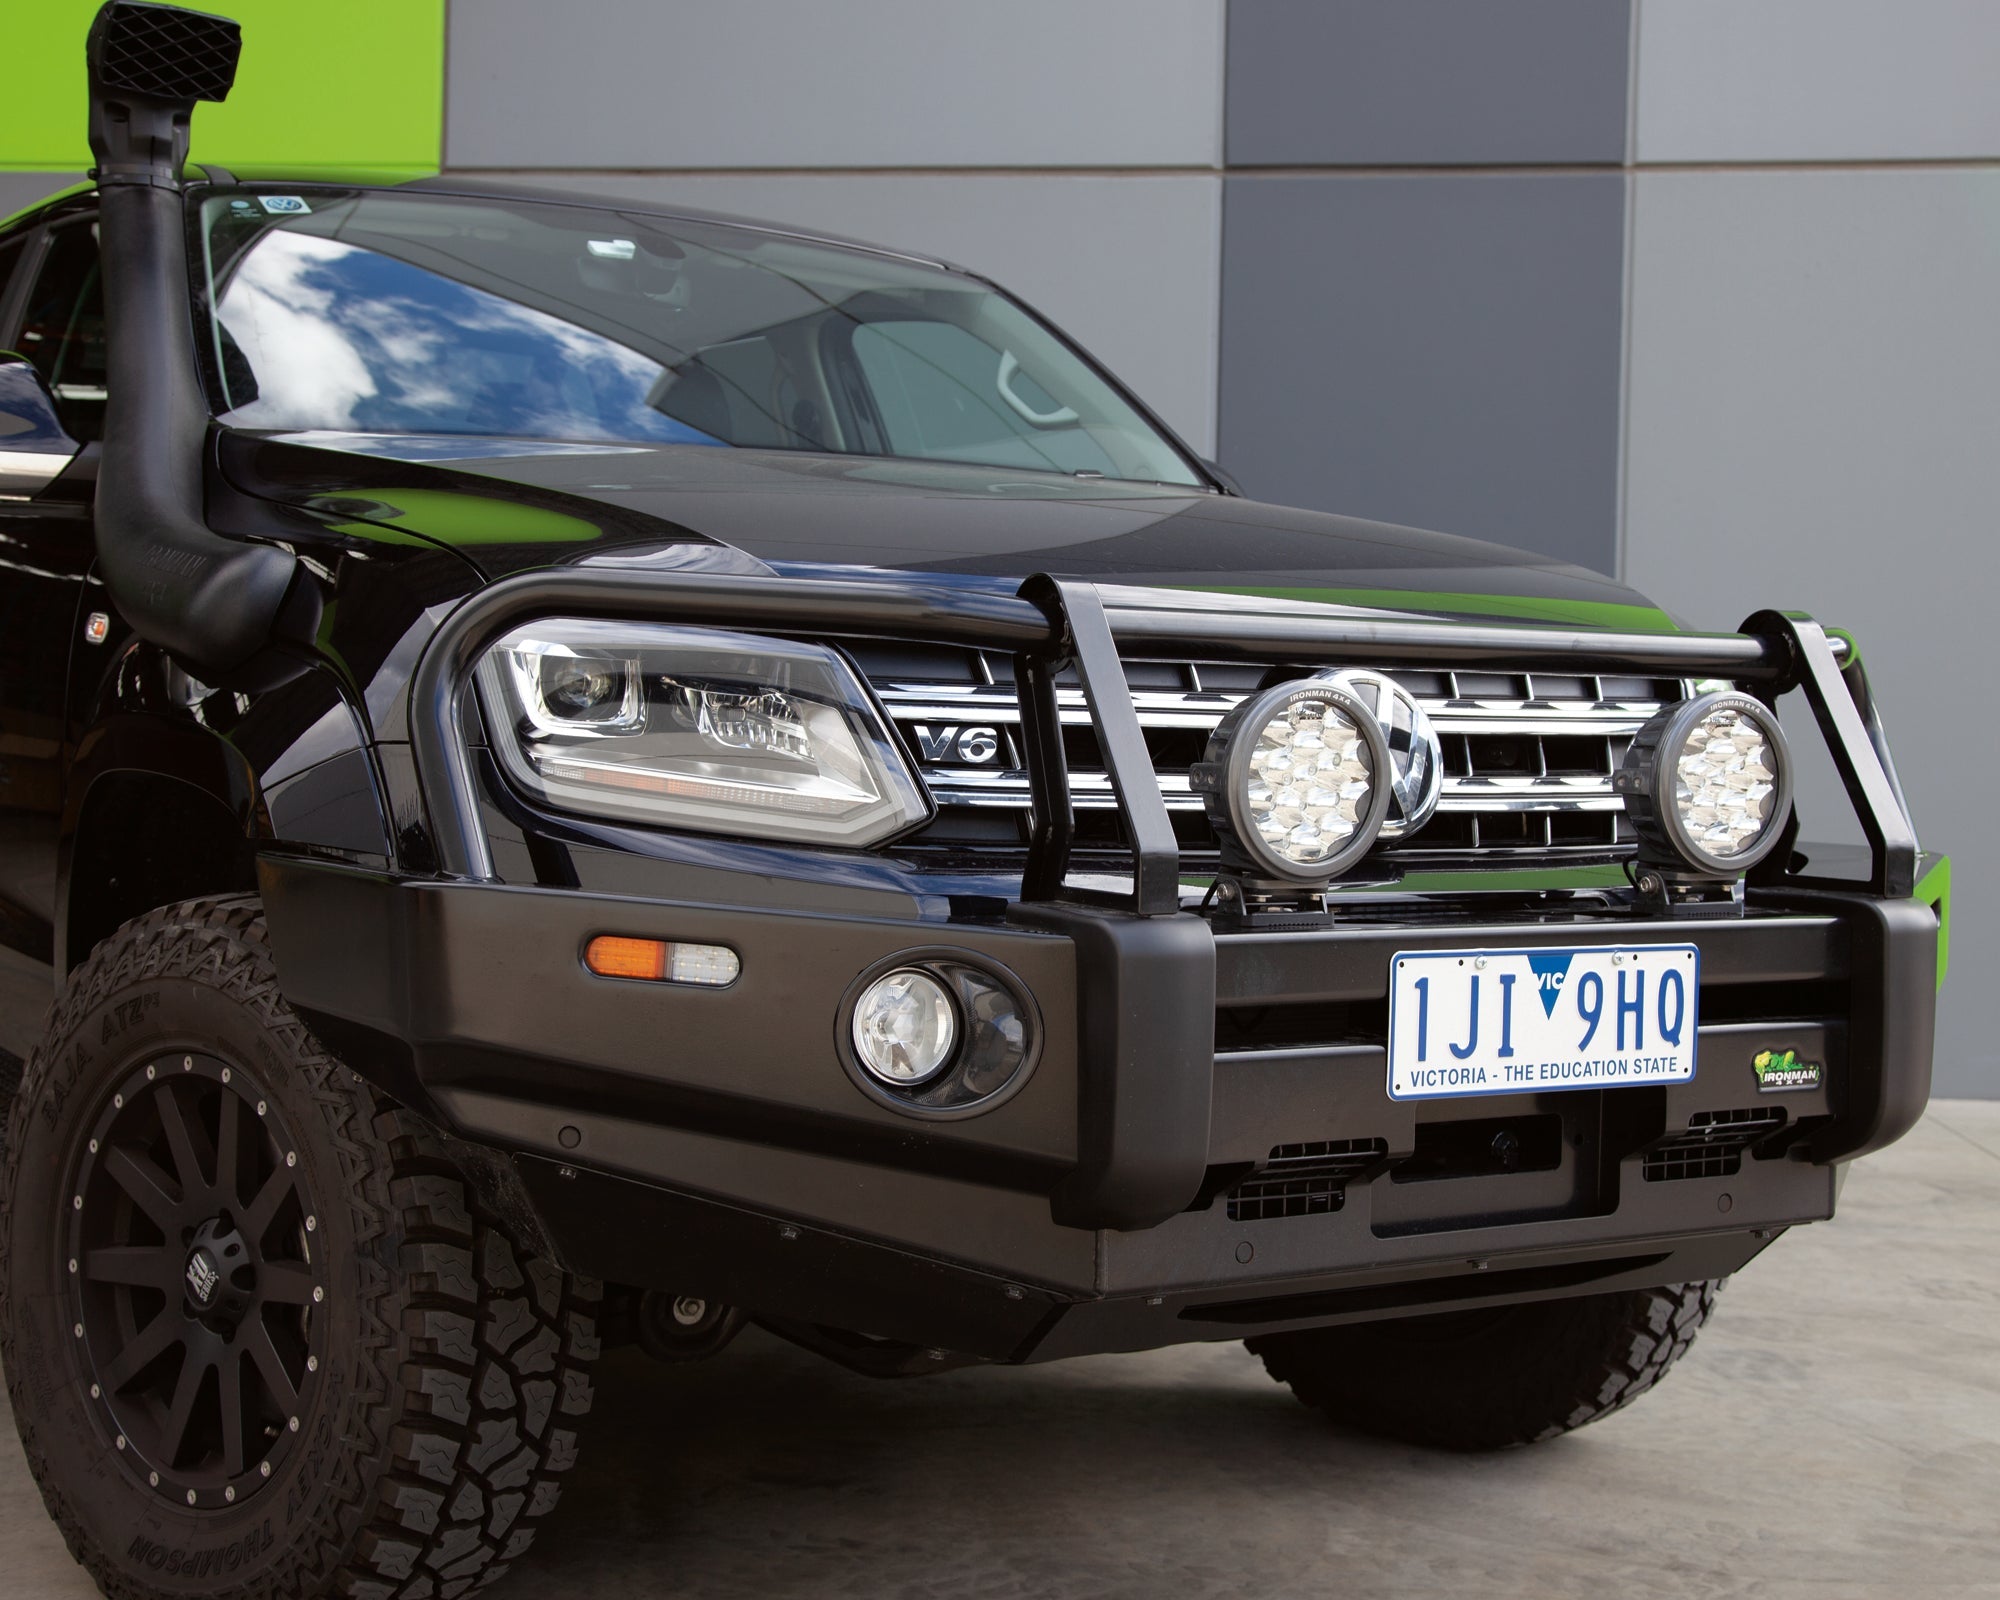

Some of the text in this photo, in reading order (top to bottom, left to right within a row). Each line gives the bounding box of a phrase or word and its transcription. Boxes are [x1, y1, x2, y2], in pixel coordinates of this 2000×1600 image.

[1290, 690, 1332, 702] IRONMAN
[1710, 700, 1745, 711] IRONMAN
[913, 725, 998, 763] V6
[1534, 972, 1565, 990] VIC
[1414, 968, 1685, 1062] 1JI 9HQ
[1411, 1067, 1487, 1087] VICTORIA
[1504, 1064, 1535, 1082] THE
[1540, 1059, 1628, 1079] EDUCATION
[1633, 1056, 1678, 1074] STATE
[1764, 1070, 1816, 1082] IRONMAN
[127, 1518, 275, 1578] THOMPSON
